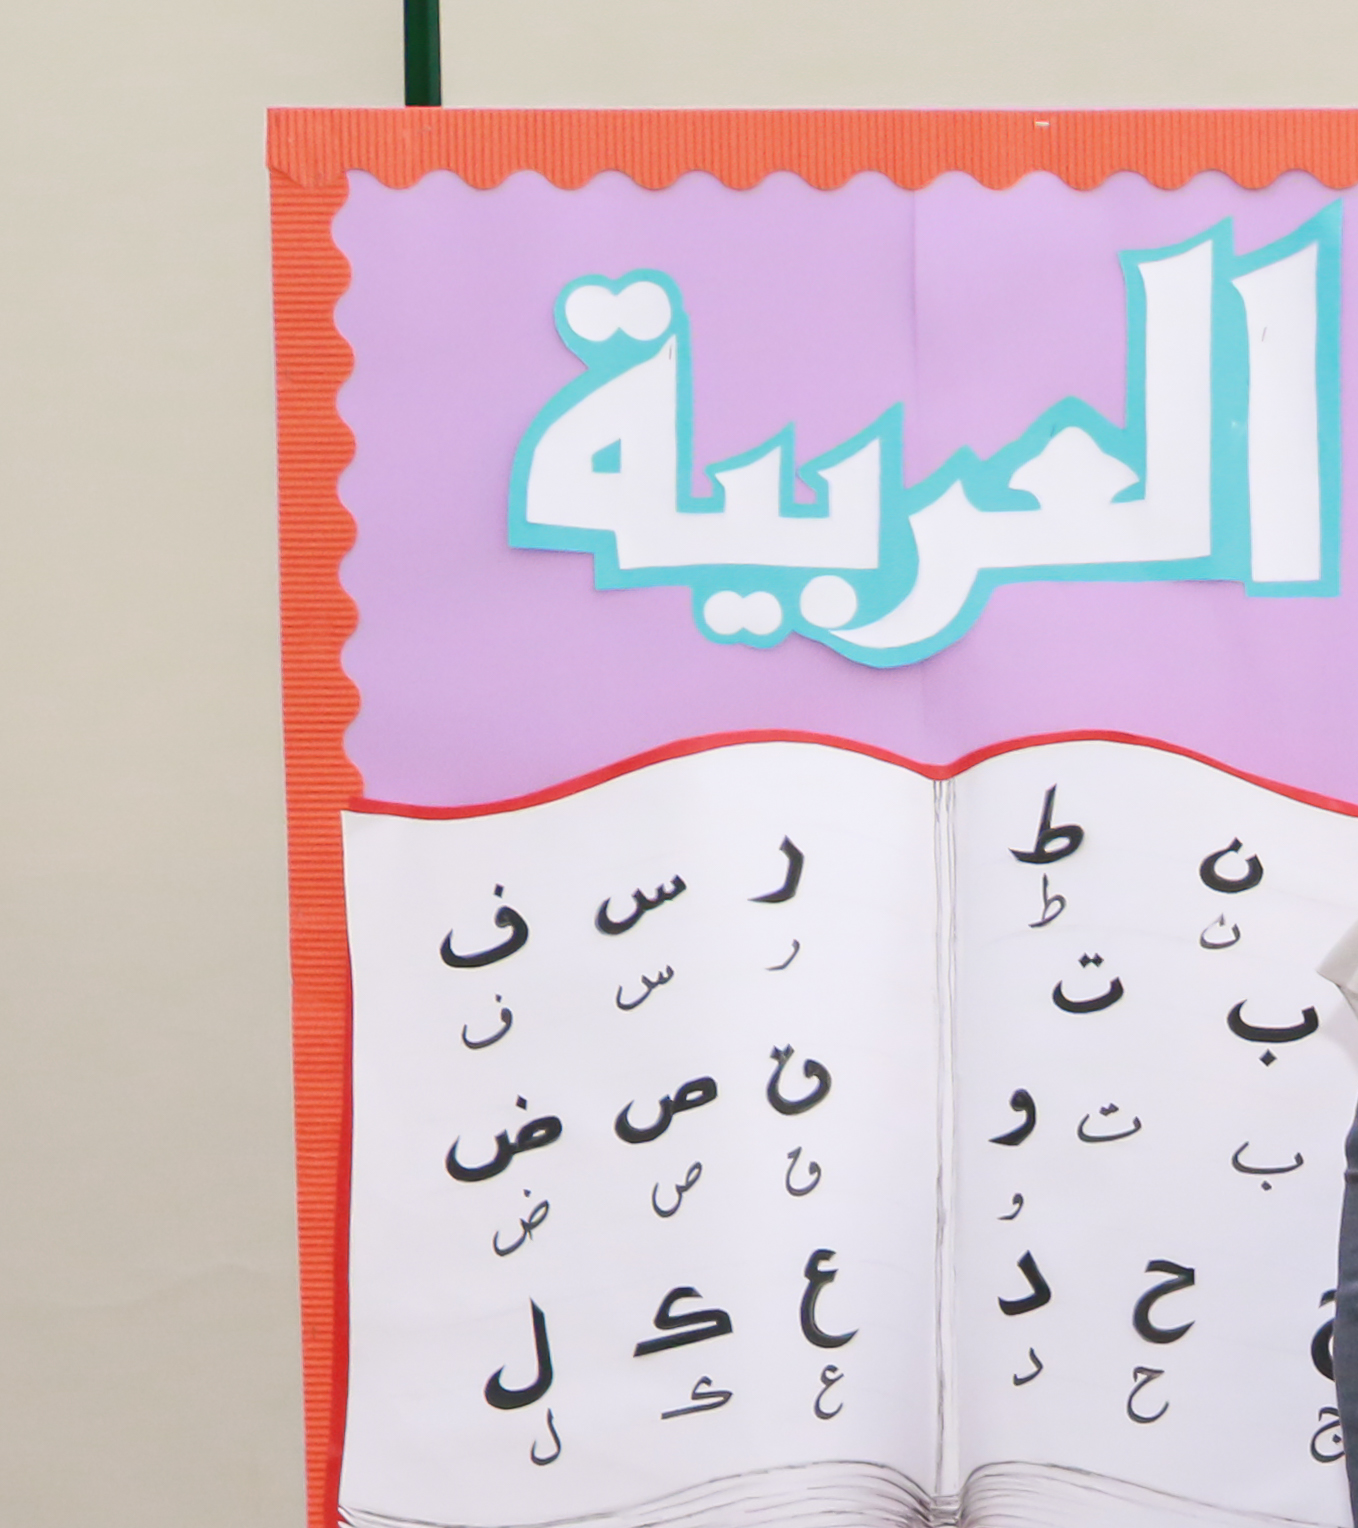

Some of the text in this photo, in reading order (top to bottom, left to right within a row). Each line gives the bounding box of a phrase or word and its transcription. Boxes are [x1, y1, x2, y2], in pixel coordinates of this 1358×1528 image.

[508, 198, 1342, 668] العربية
[1010, 785, 1084, 865] ط
[751, 836, 804, 904] ر
[1200, 838, 1263, 894] ن
[440, 884, 529, 968] ف
[595, 875, 686, 936] س
[1029, 874, 1066, 928] ط
[768, 940, 800, 971] ر
[1200, 915, 1240, 950] ن
[616, 966, 674, 1011] س
[1052, 953, 1124, 1014] ت
[462, 995, 513, 1050] ف
[1227, 1001, 1319, 1066] ب
[767, 1045, 831, 1116] ق
[446, 1096, 562, 1183] ض
[615, 1077, 717, 1144] ص
[989, 1089, 1036, 1146] و
[1077, 1103, 1141, 1143] ت
[652, 1162, 702, 1218] ص
[1232, 1142, 1304, 1190] ب
[493, 1190, 550, 1257] ض
[999, 1193, 1024, 1220] و
[800, 1249, 858, 1349] ع
[998, 1250, 1051, 1316] د
[1133, 1260, 1195, 1344] ح
[633, 1287, 733, 1357] ك
[484, 1298, 553, 1410] ل
[1013, 1348, 1043, 1386] د
[661, 1376, 733, 1419] ك
[814, 1365, 844, 1420] ع
[1127, 1366, 1169, 1424] ح
[531, 1408, 561, 1466] ل
